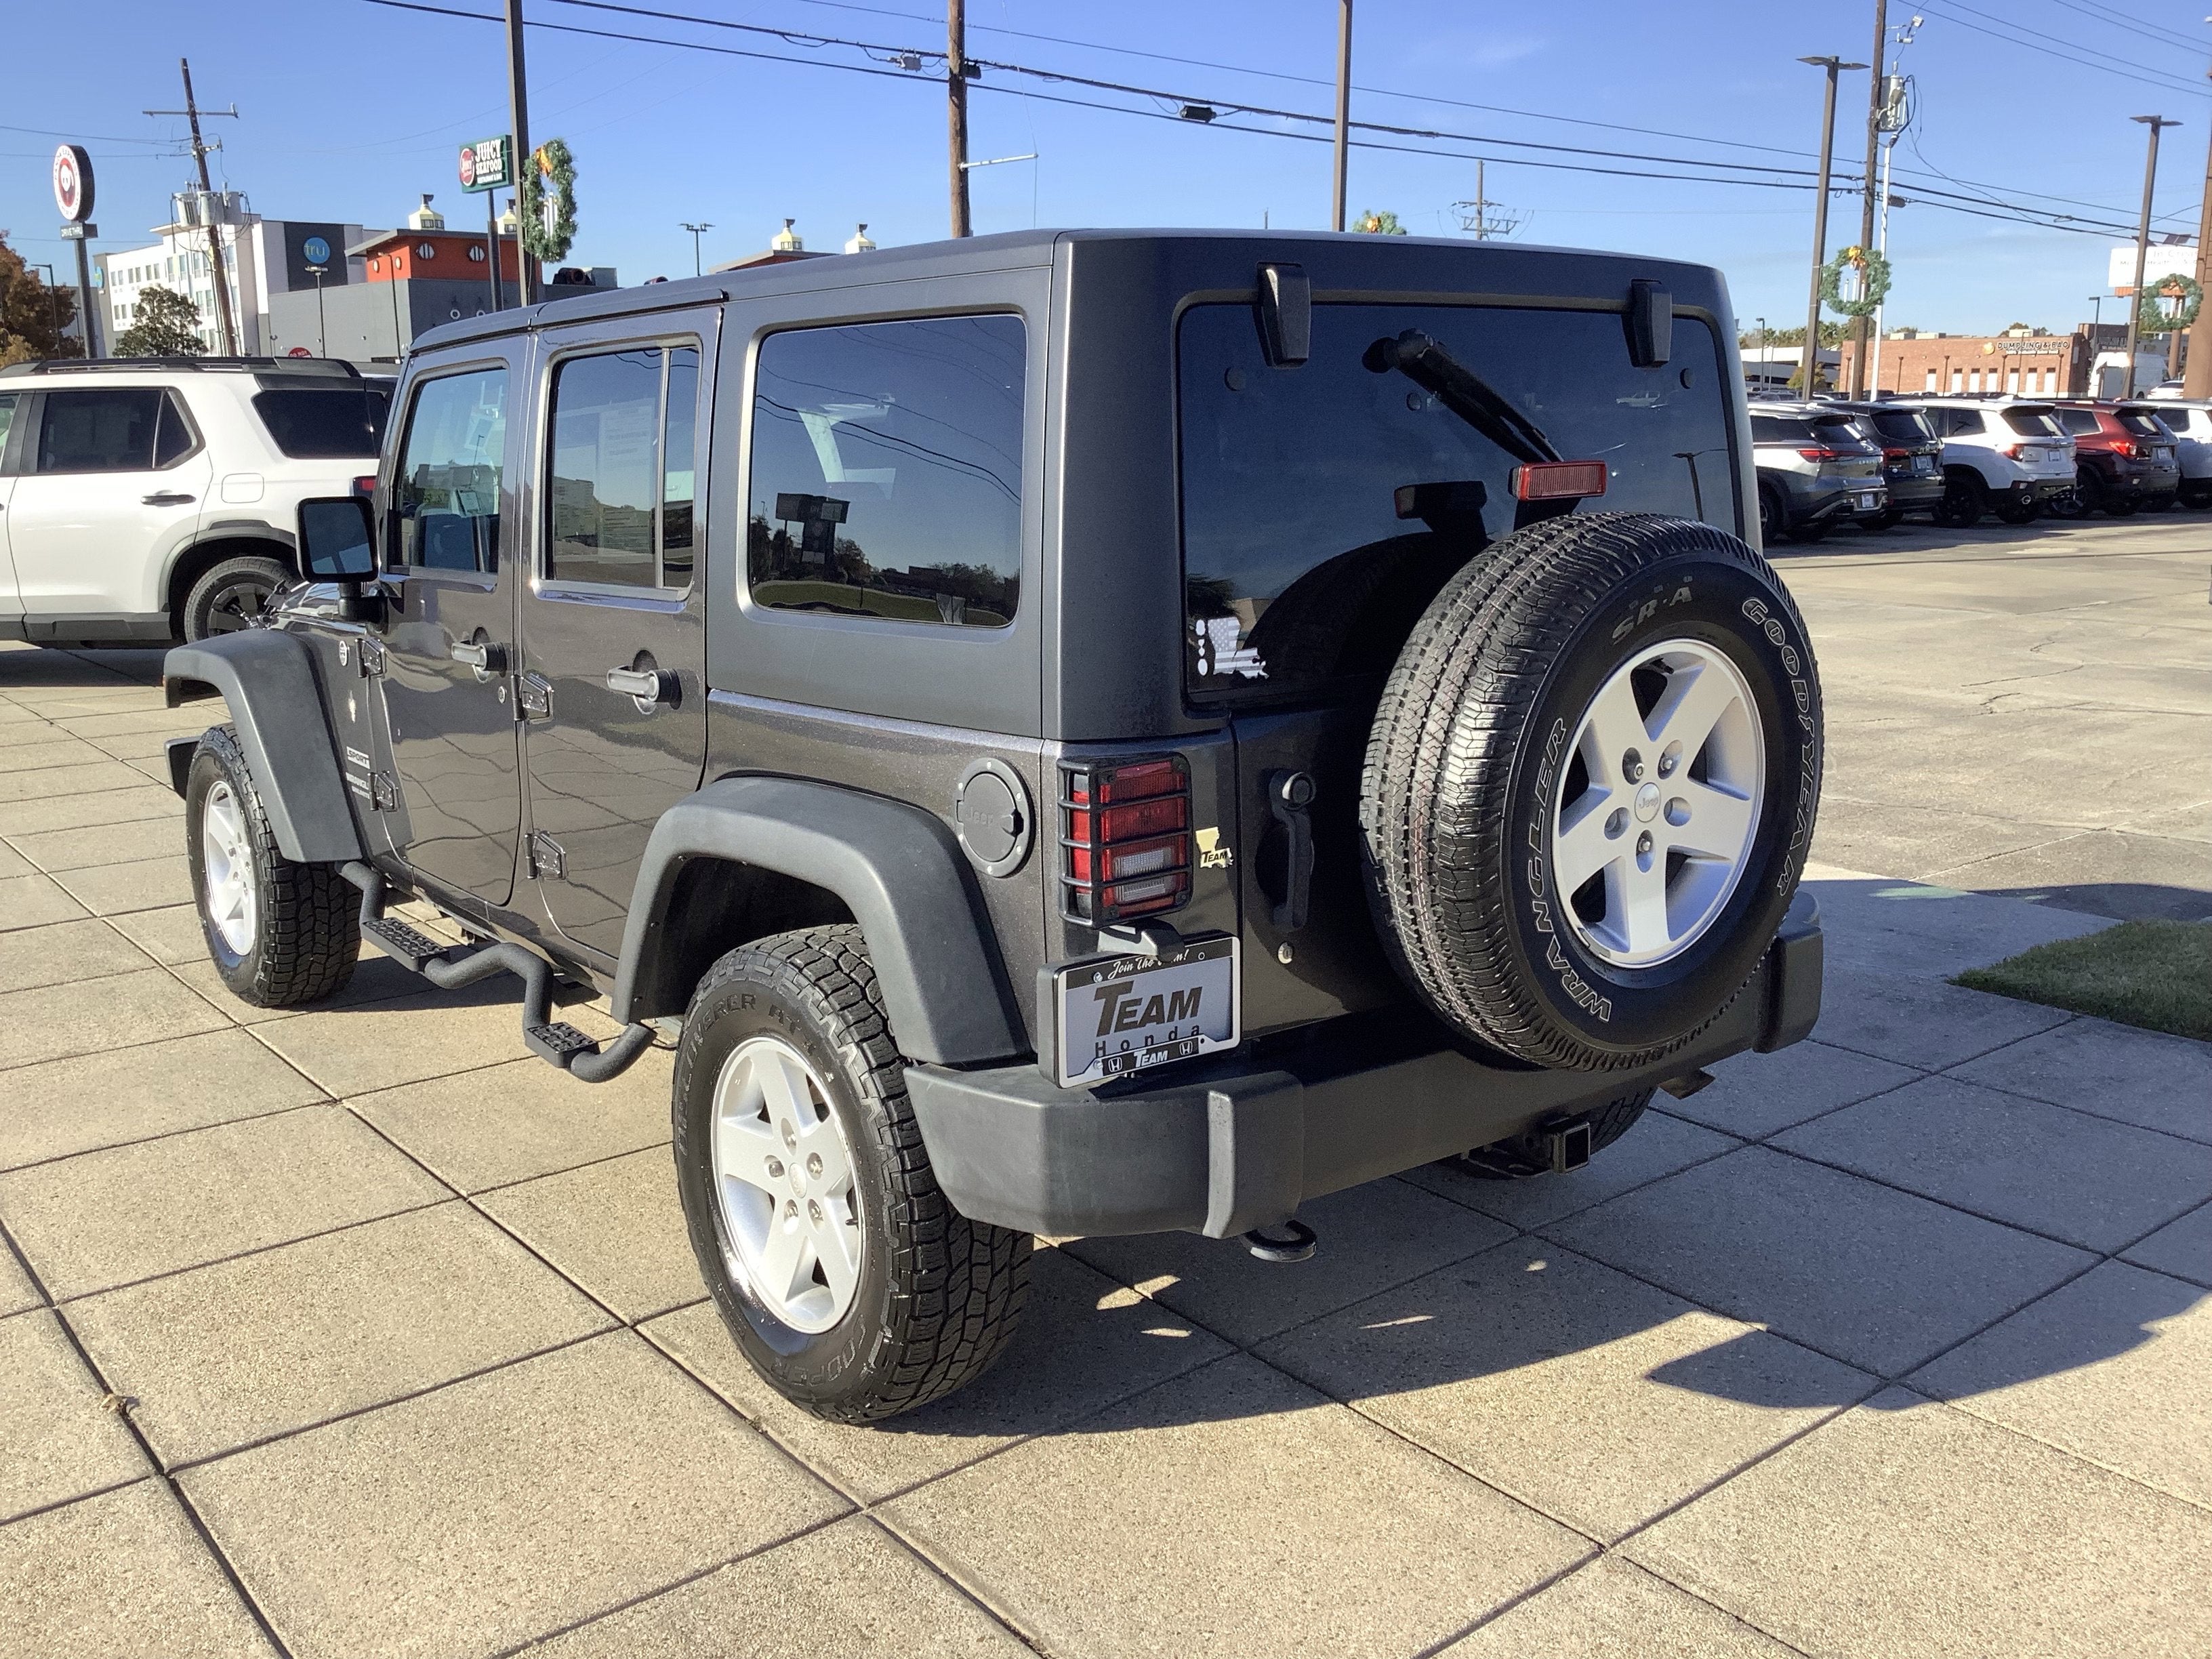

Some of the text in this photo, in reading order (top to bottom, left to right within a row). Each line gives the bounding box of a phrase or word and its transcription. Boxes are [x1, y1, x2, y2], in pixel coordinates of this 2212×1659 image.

[475, 139, 501, 162] JUICY
[476, 158, 502, 176] SEAFOOD
[61, 228, 72, 237] DRIVE
[304, 243, 325, 256] tru
[2051, 341, 2068, 349] BAO
[1742, 596, 1815, 897] GOODYEAR
[348, 750, 369, 765] SPORT
[1639, 796, 1659, 809] Jeep
[1202, 850, 1228, 864] TEAM
[1527, 717, 1612, 1023] WRANGLER
[1107, 960, 1134, 979] Join
[1135, 956, 1155, 970] The
[1093, 980, 1203, 1038] TEAM
[1094, 1024, 1200, 1059] Honda
[1133, 1049, 1168, 1068] TEAM
